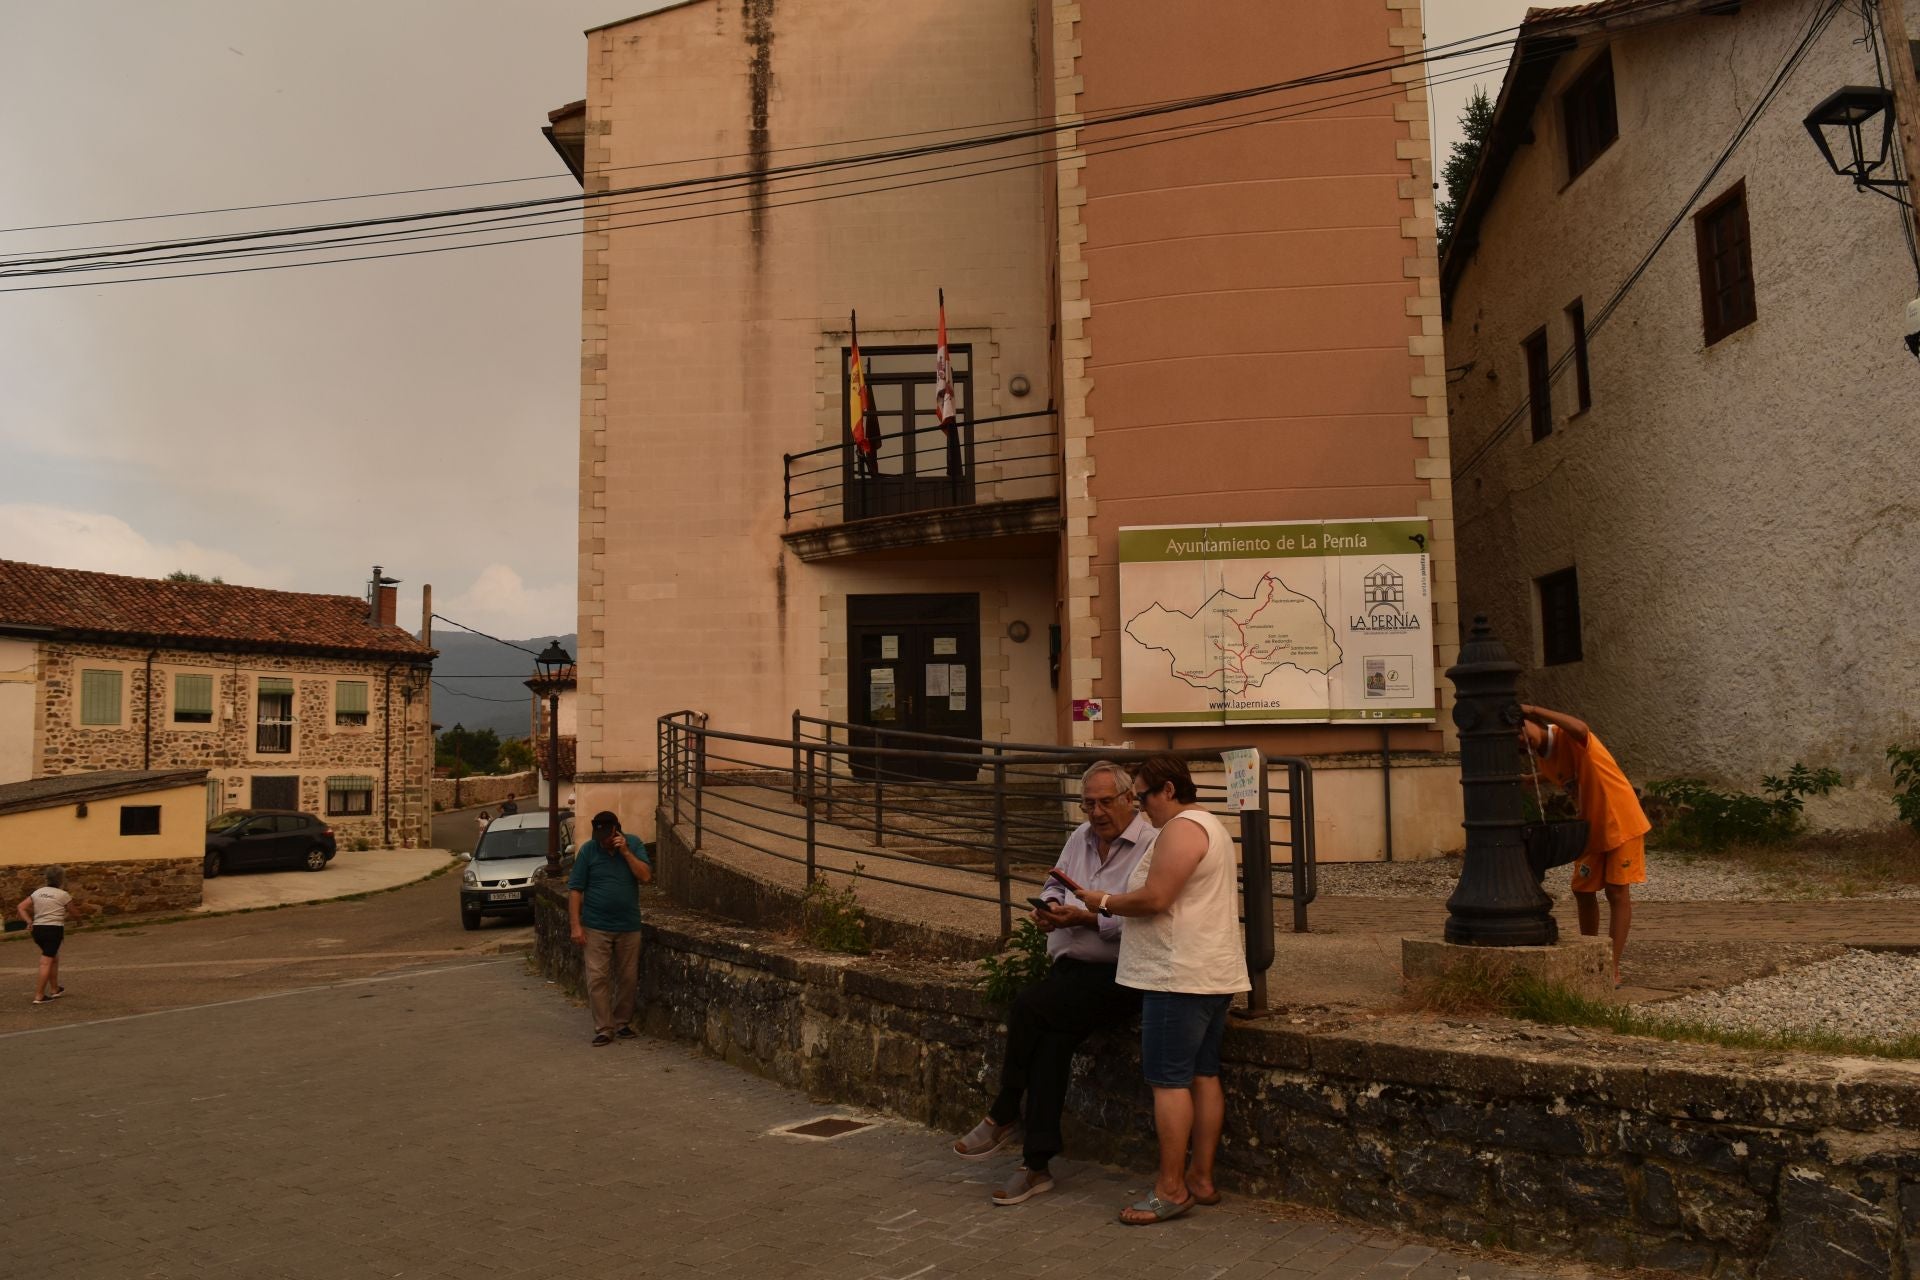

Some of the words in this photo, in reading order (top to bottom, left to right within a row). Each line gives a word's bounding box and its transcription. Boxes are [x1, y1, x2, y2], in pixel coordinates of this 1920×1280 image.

[1165, 537, 1270, 555] Ayuntamiento
[1276, 535, 1295, 550] de
[1301, 534, 1317, 549] La
[1323, 533, 1368, 549] Pernía
[1350, 615, 1366, 628] LA
[1371, 611, 1420, 627] PERNÍA
[1209, 700, 1280, 709] www.lapernia.es
